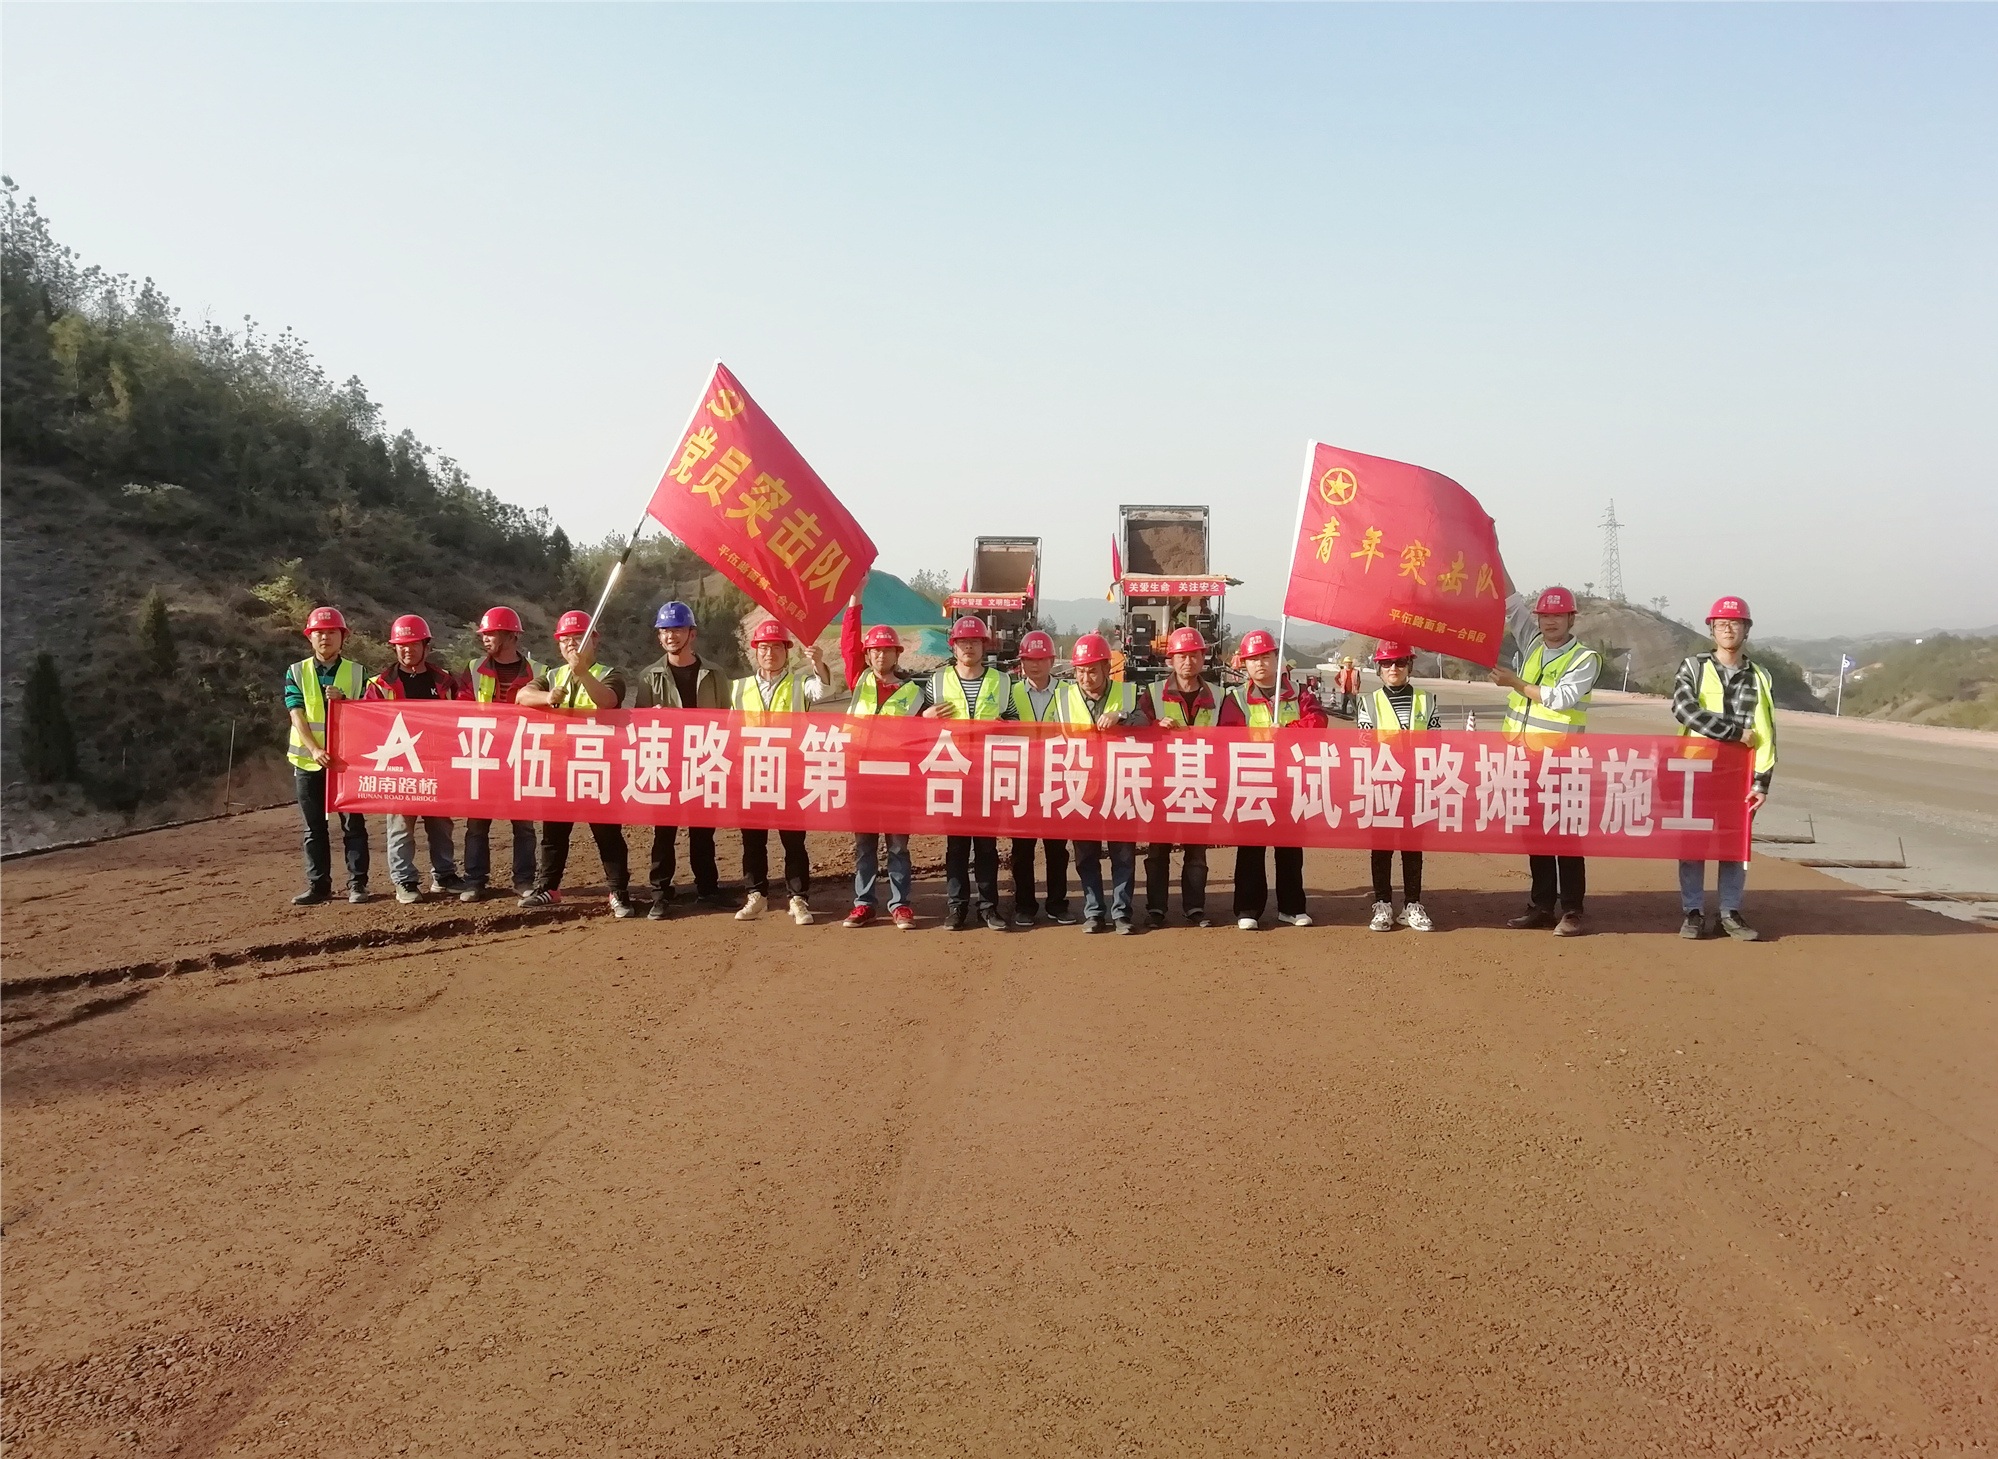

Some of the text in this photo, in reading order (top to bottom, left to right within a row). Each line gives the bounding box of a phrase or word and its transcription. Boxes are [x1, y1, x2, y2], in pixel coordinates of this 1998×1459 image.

[669, 425, 851, 603] 党员突击队
[717, 543, 807, 623] 平伍路面第一合同段
[1310, 516, 1498, 599] 青年突击队
[1129, 582, 1219, 592] 关爱生命 关注安全
[1389, 608, 1486, 643] 平伍路面第一合同段
[357, 792, 383, 800] HUNAN
[411, 795, 438, 803] BRIDGE
[358, 775, 438, 795] 湖南路桥
[451, 715, 1714, 837] 平伍高速路面第一合同段底基层试验路摊铺施工
